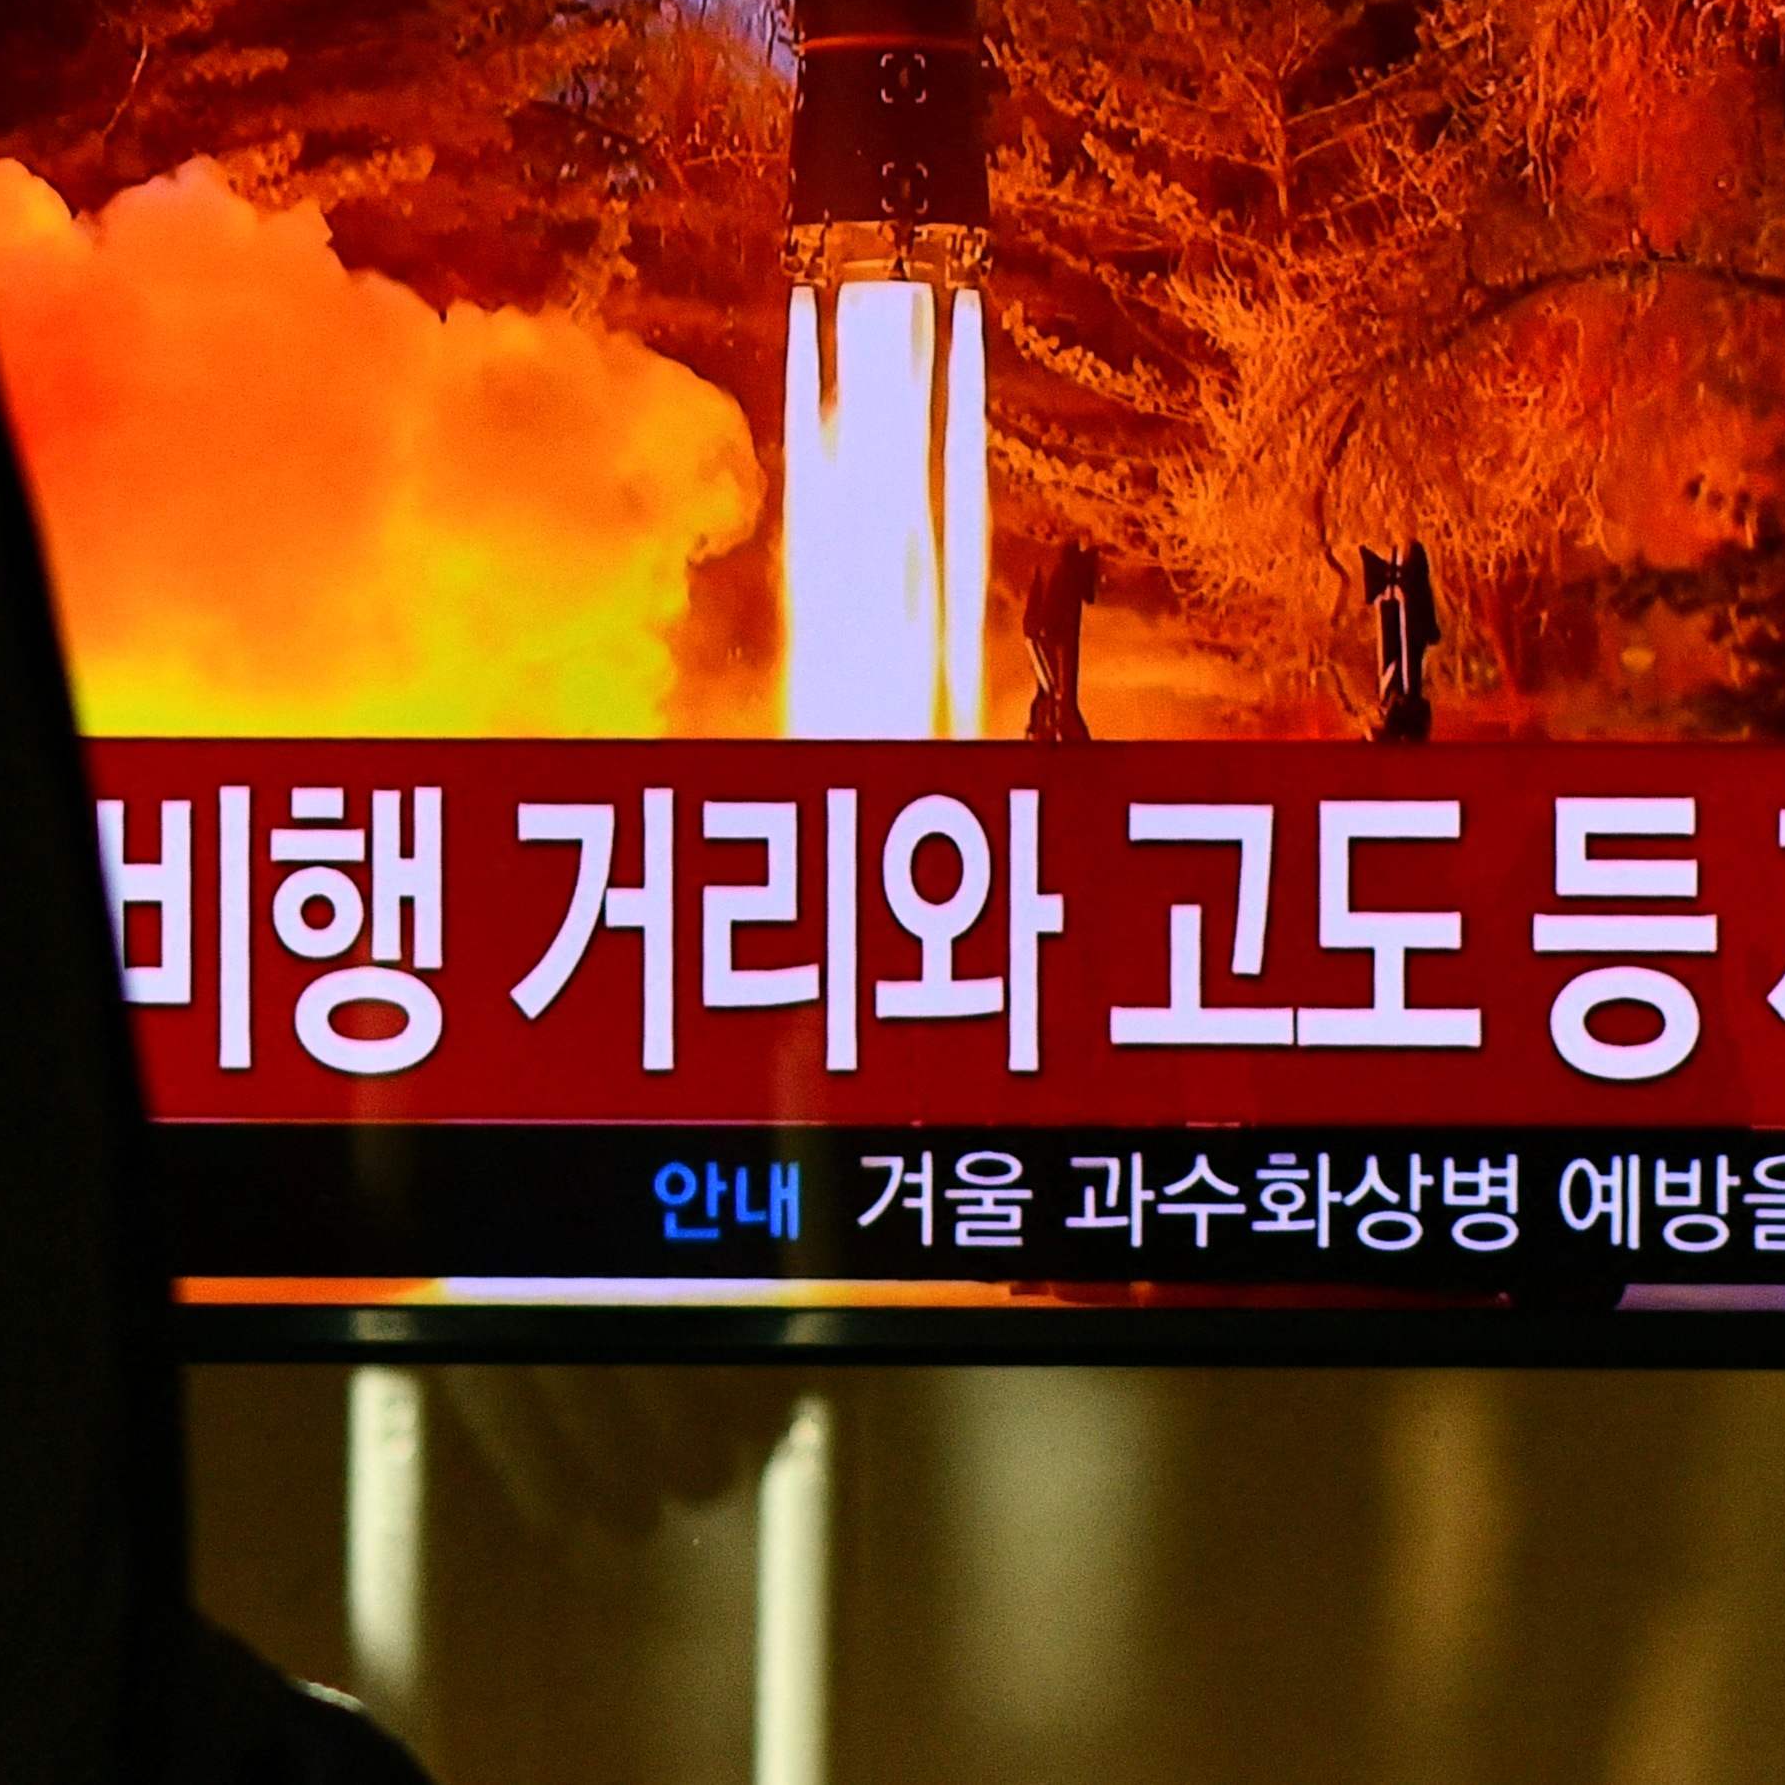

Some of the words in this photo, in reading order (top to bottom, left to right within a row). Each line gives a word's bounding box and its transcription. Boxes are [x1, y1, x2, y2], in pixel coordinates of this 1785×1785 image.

[95, 784, 444, 1076] 비행
[509, 786, 1066, 1073] 거리와
[1109, 798, 1483, 1048] 고도
[1532, 795, 1719, 1081] 등
[652, 1159, 802, 1243] 안내
[857, 1150, 1034, 1248] 겨울
[1064, 1151, 1520, 1252] 과수화상병
